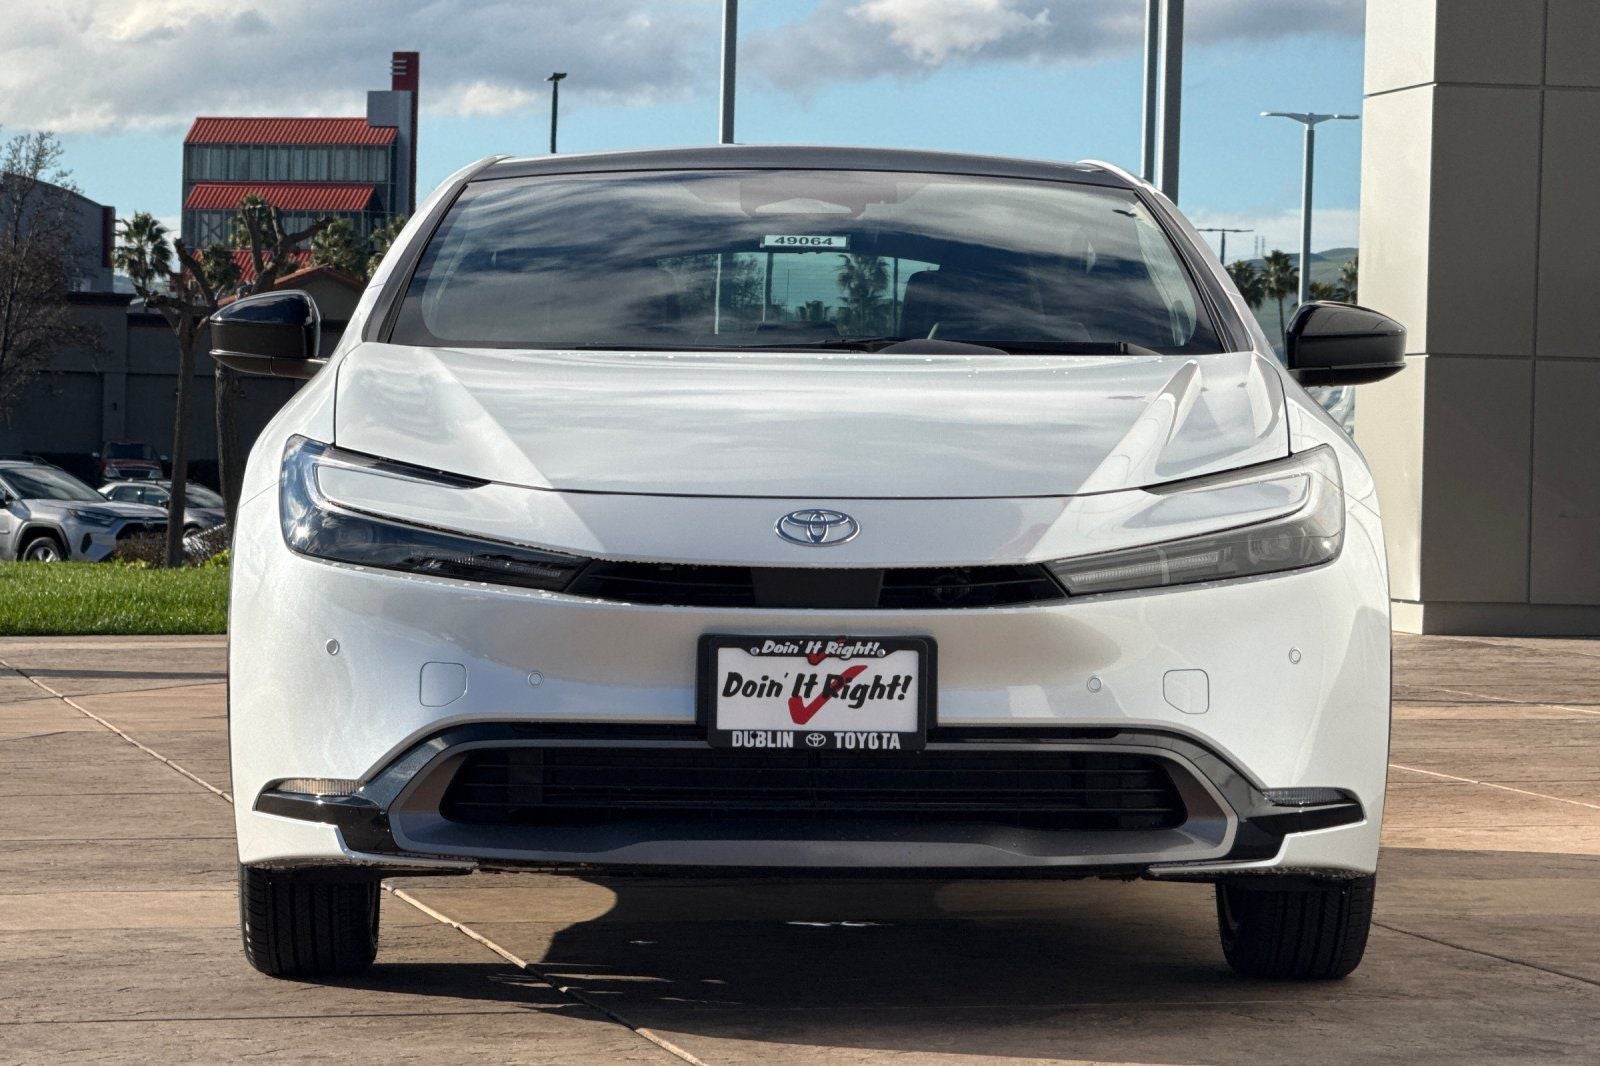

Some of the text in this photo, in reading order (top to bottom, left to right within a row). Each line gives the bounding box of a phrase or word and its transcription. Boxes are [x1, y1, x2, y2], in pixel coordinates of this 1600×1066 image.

[774, 236, 833, 246] 49064
[761, 640, 880, 661] Doin' It Right!
[722, 671, 913, 709] Doin' It Right!
[731, 730, 901, 750] DUBLIN TOYOTA
